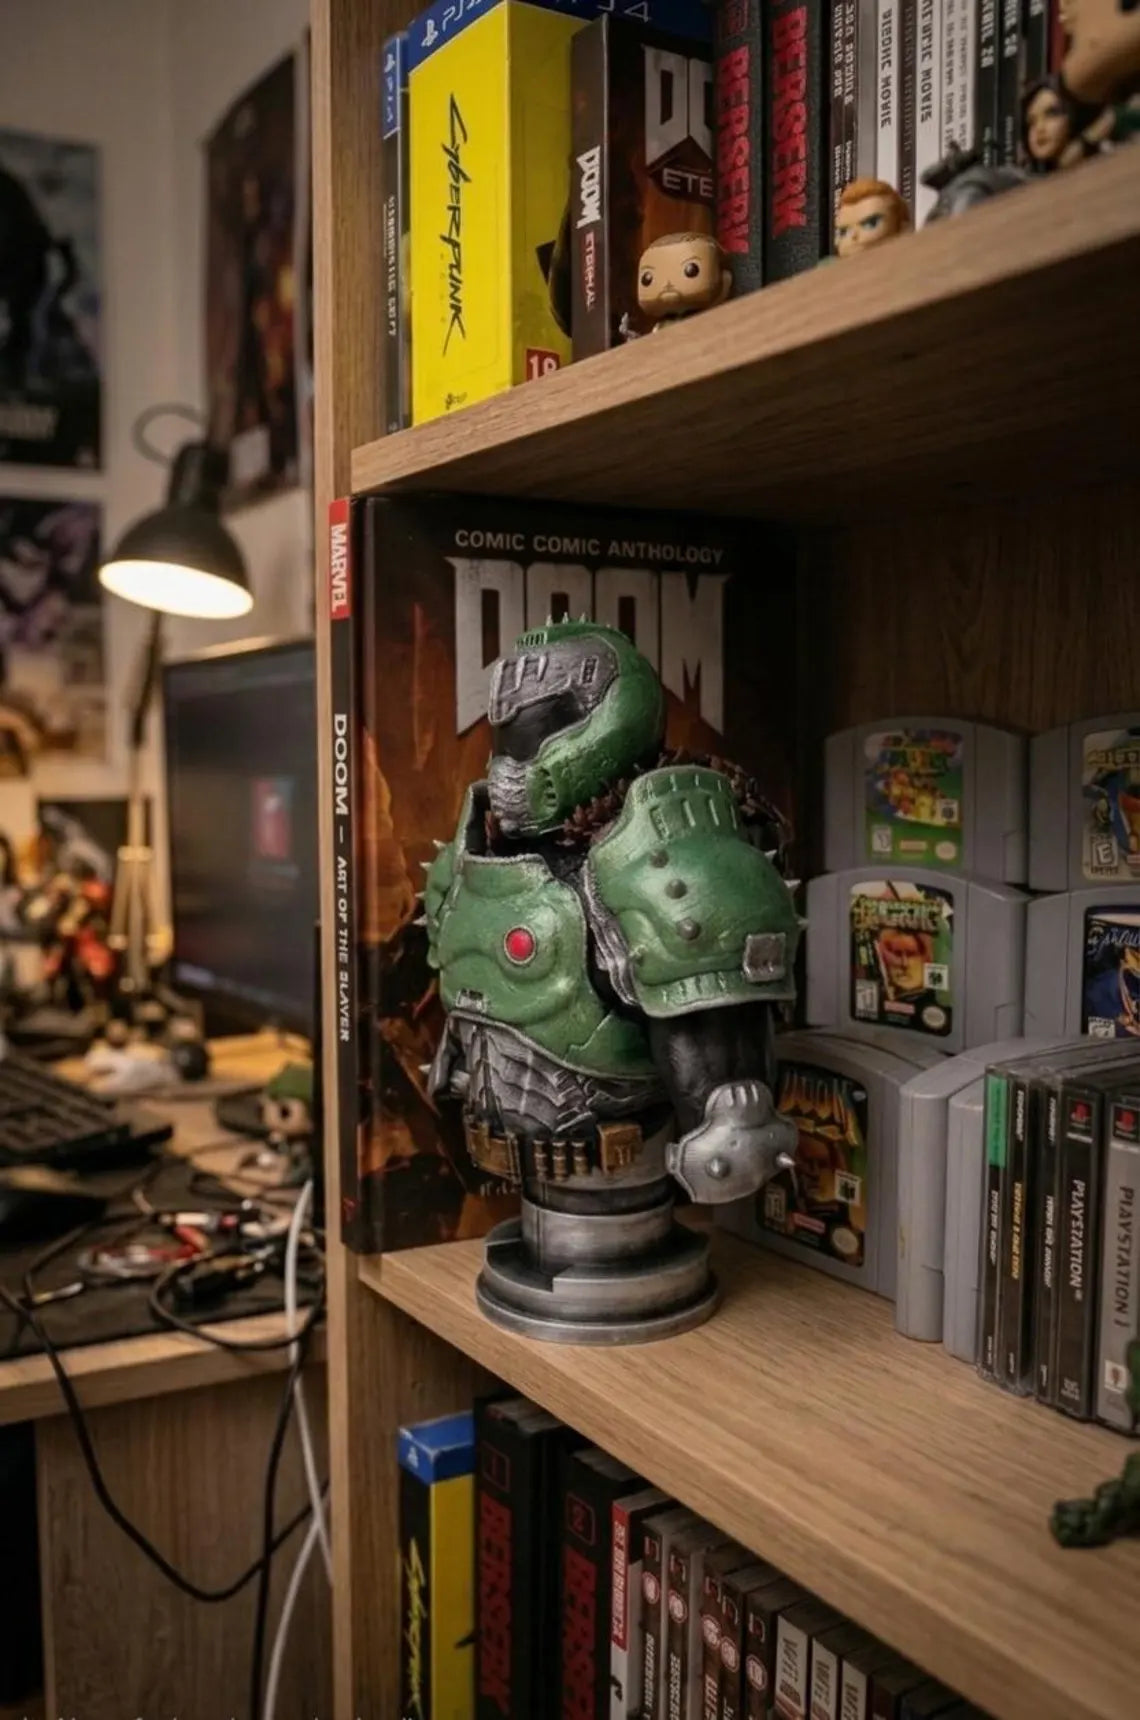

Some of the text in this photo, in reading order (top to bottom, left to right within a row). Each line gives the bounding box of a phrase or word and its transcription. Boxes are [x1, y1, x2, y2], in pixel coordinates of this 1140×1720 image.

[771, 5, 807, 240] BERSERK
[576, 145, 602, 230] DOOM
[330, 523, 347, 613] MARVEL
[455, 530, 723, 565] COMIC COMIC ANTHOLOGY
[444, 556, 731, 737] DOOM
[334, 713, 349, 816] DOOM
[337, 855, 348, 894] ART
[338, 897, 349, 923] OF
[338, 928, 349, 963] THE
